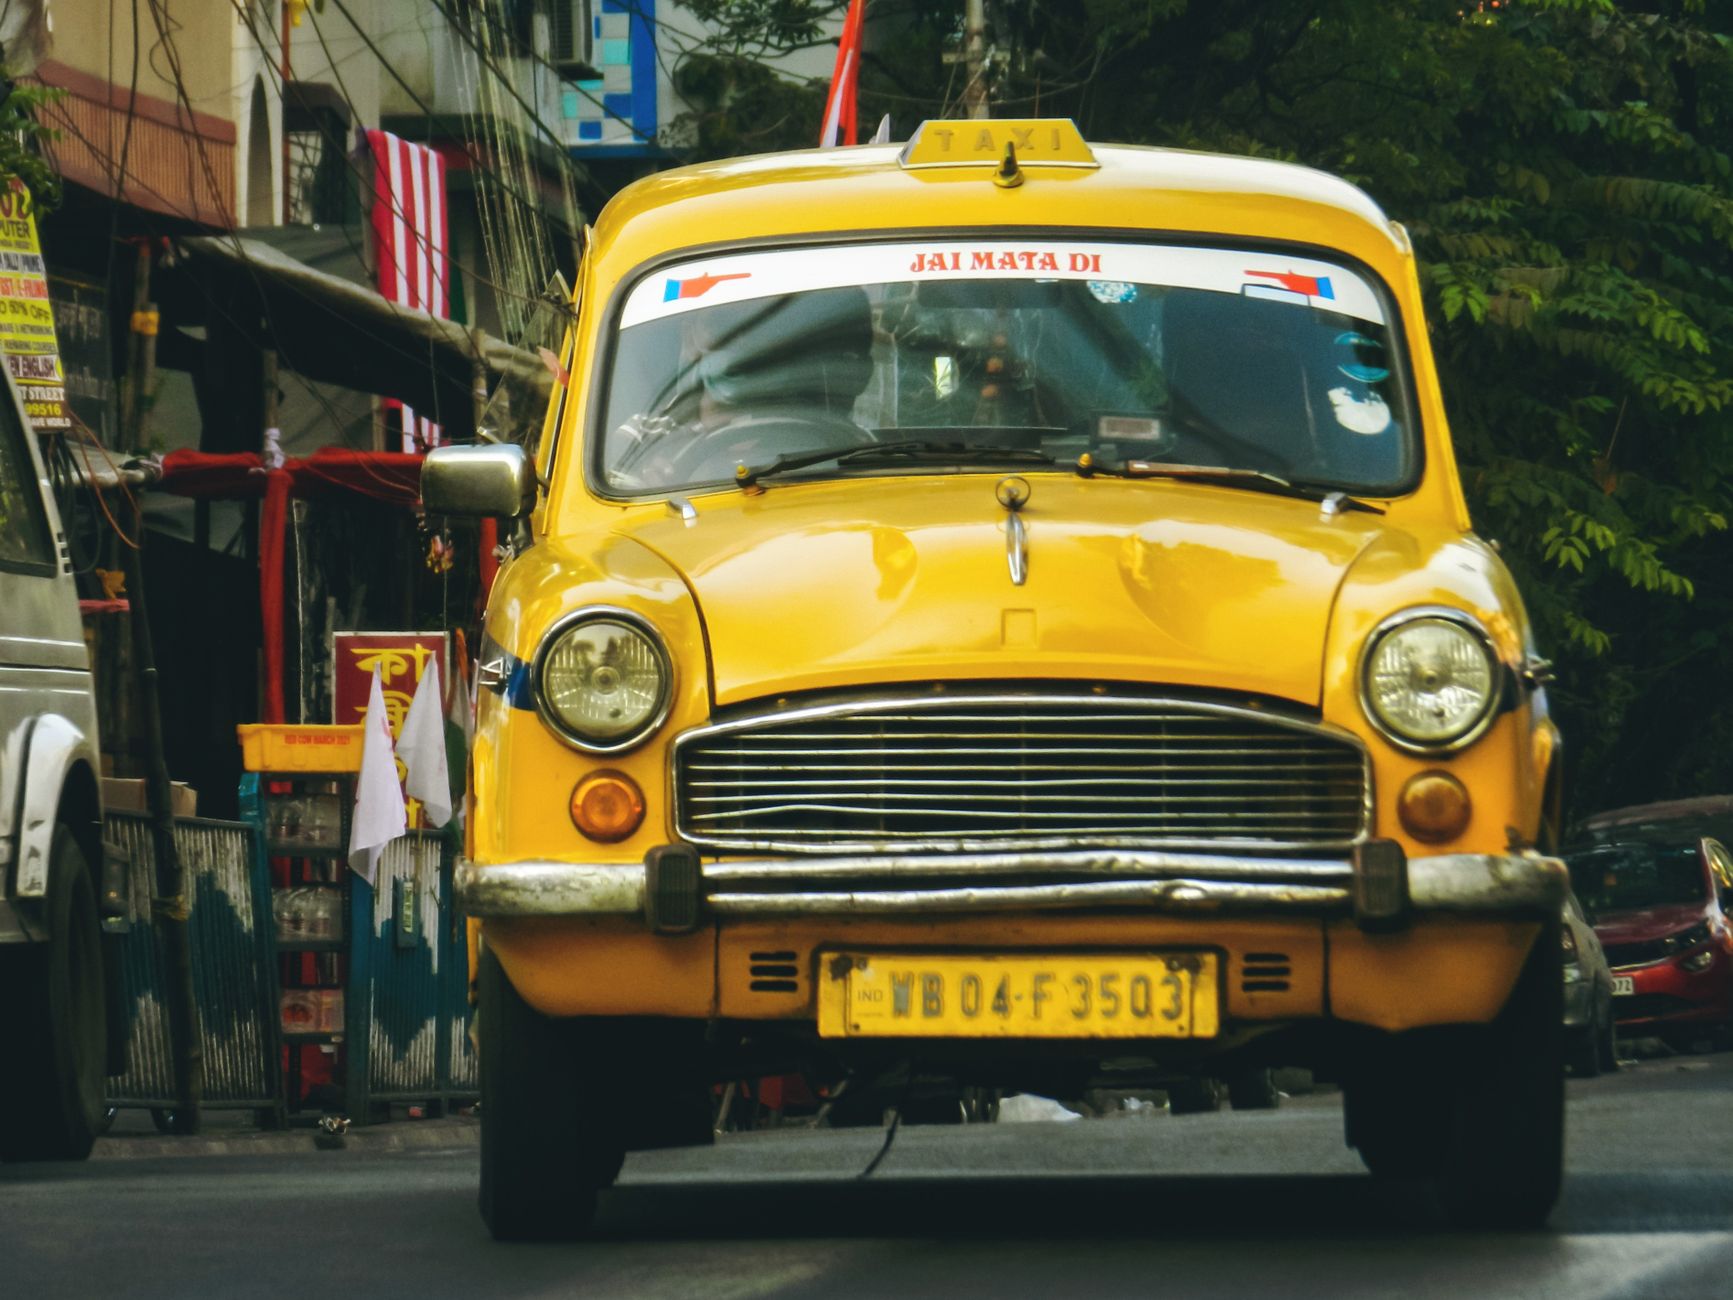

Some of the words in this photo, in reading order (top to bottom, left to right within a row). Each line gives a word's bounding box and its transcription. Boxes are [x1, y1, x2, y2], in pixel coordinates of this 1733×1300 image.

[934, 128, 1061, 152] TAXI
[910, 252, 960, 273] JAI
[970, 251, 1060, 271] MATA
[1069, 252, 1102, 273] DI
[28, 386, 65, 401] STREET
[858, 990, 884, 1002] IND
[890, 971, 944, 1018] WB
[1070, 971, 1184, 1018] 3503
